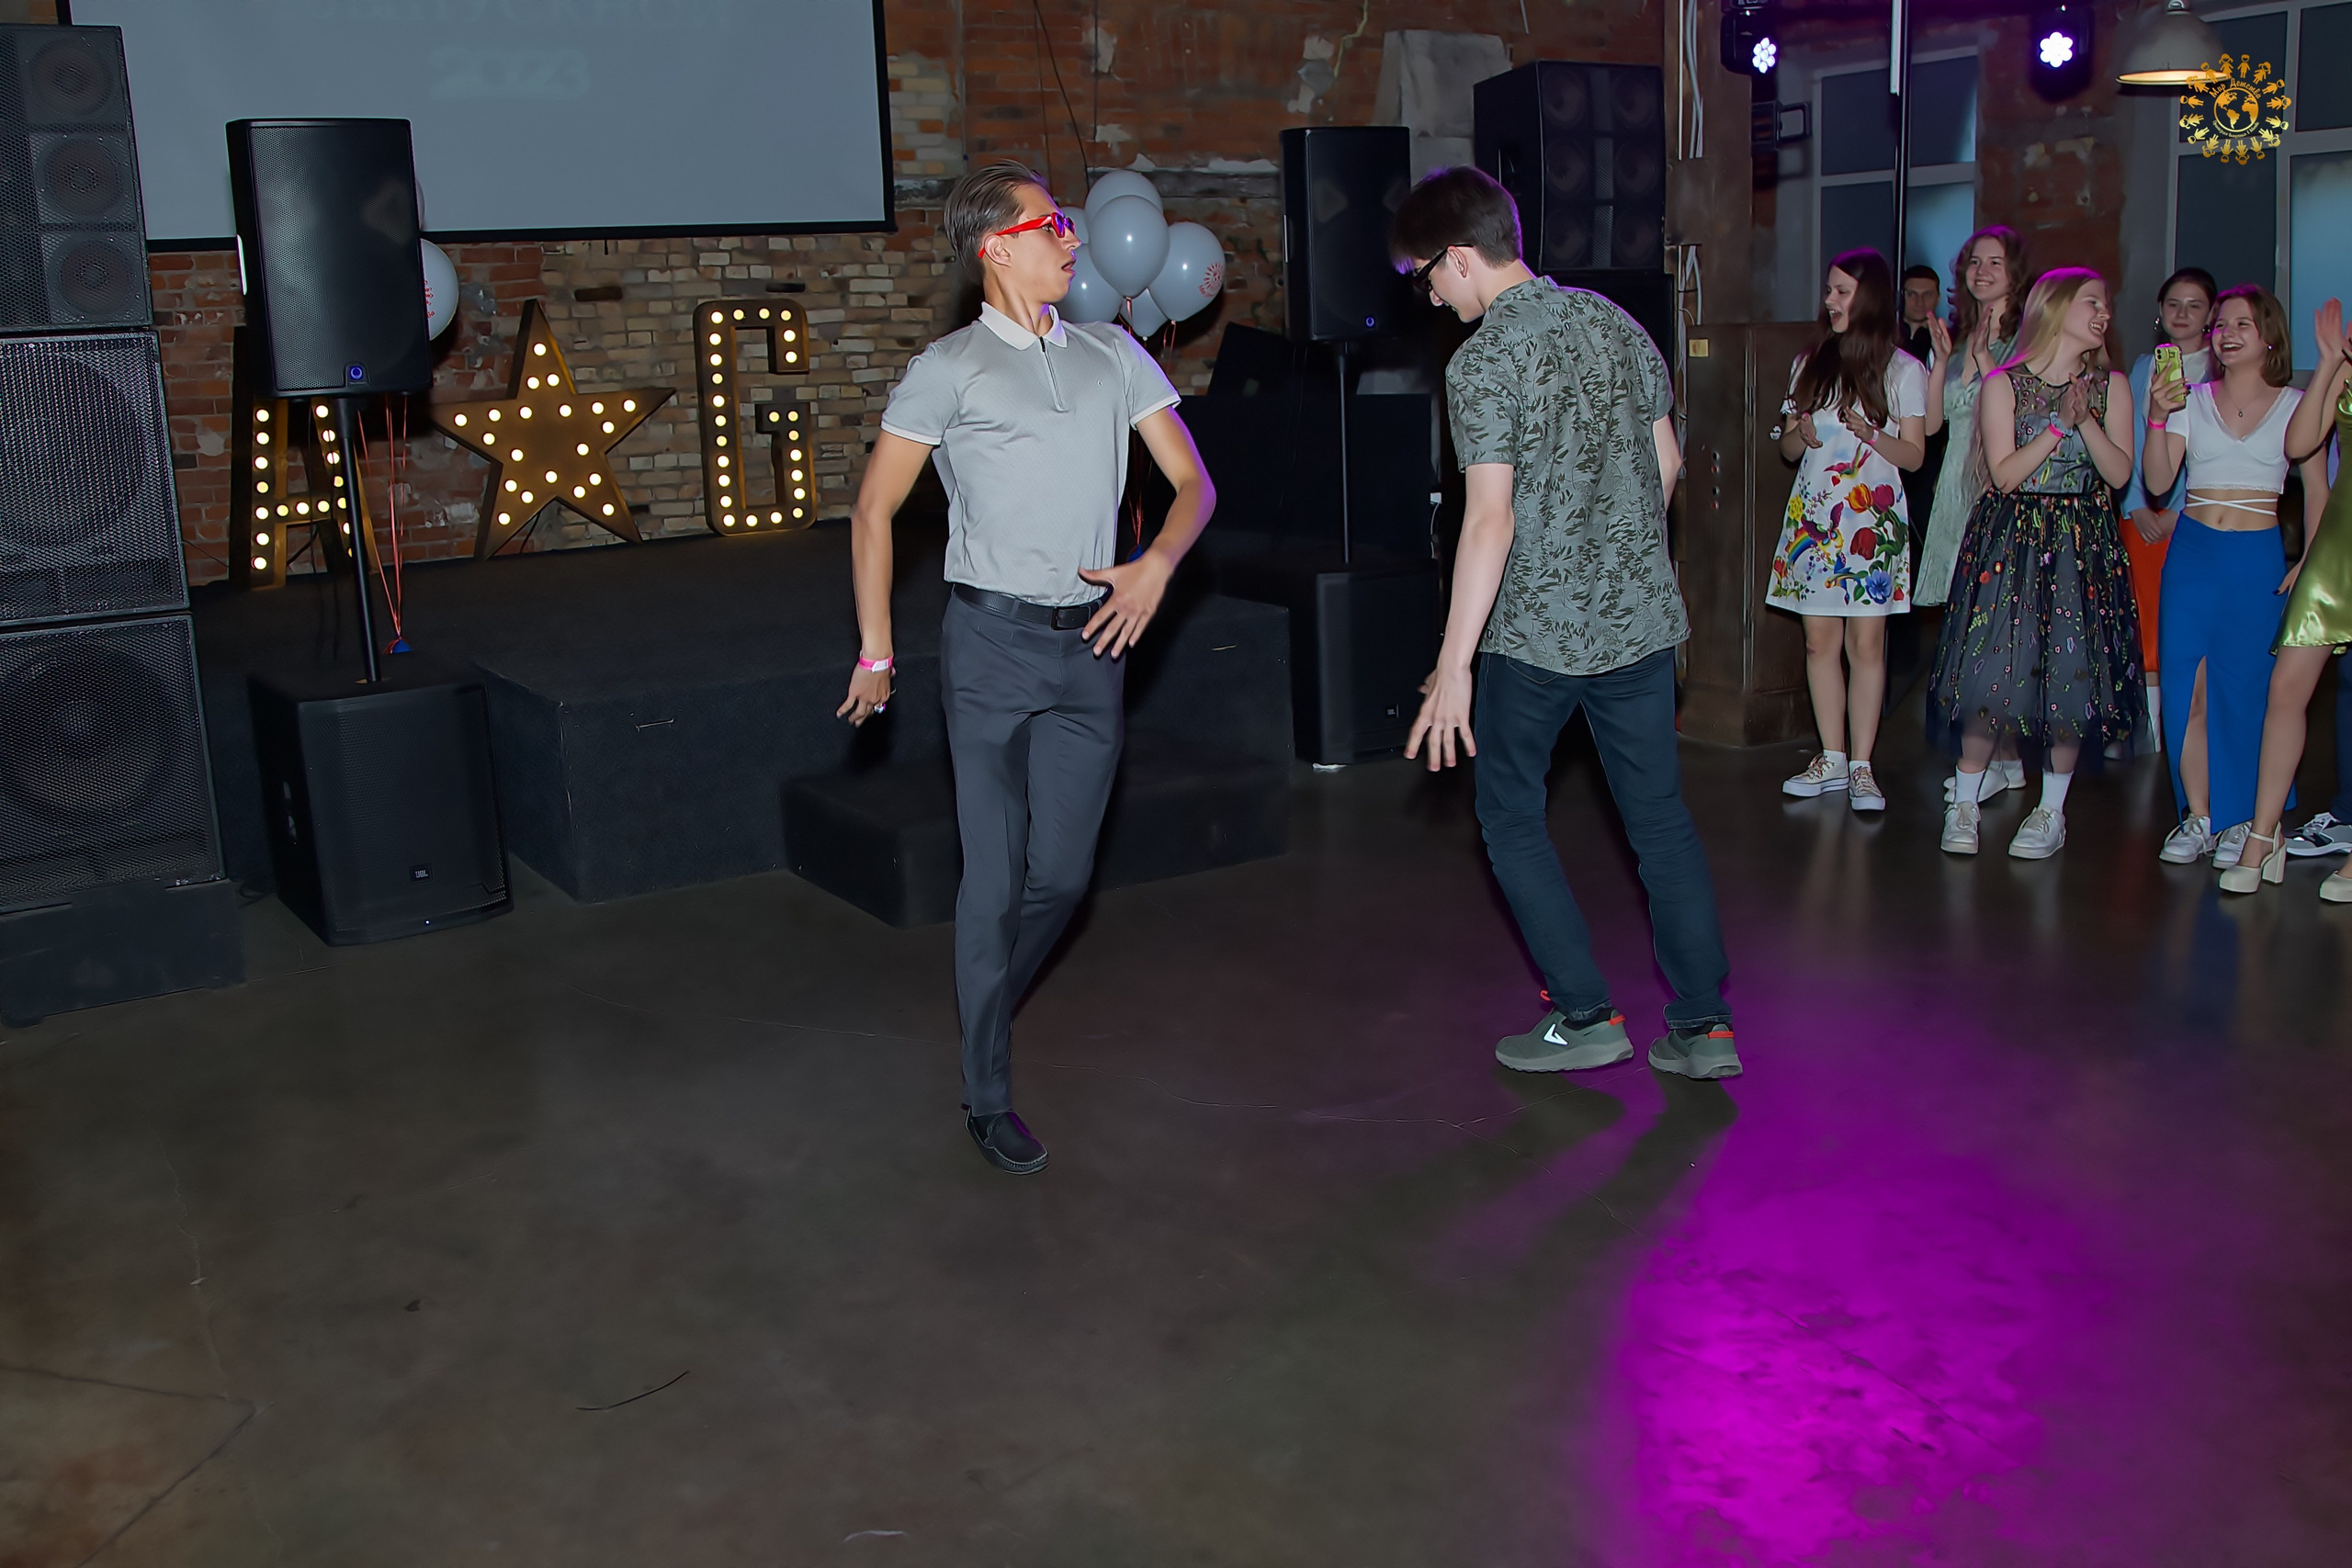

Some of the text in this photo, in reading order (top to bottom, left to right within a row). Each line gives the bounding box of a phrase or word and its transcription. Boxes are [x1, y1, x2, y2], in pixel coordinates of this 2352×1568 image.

[428, 44, 592, 99] 2023
[693, 299, 817, 536] G
[415, 870, 428, 878] JBL
